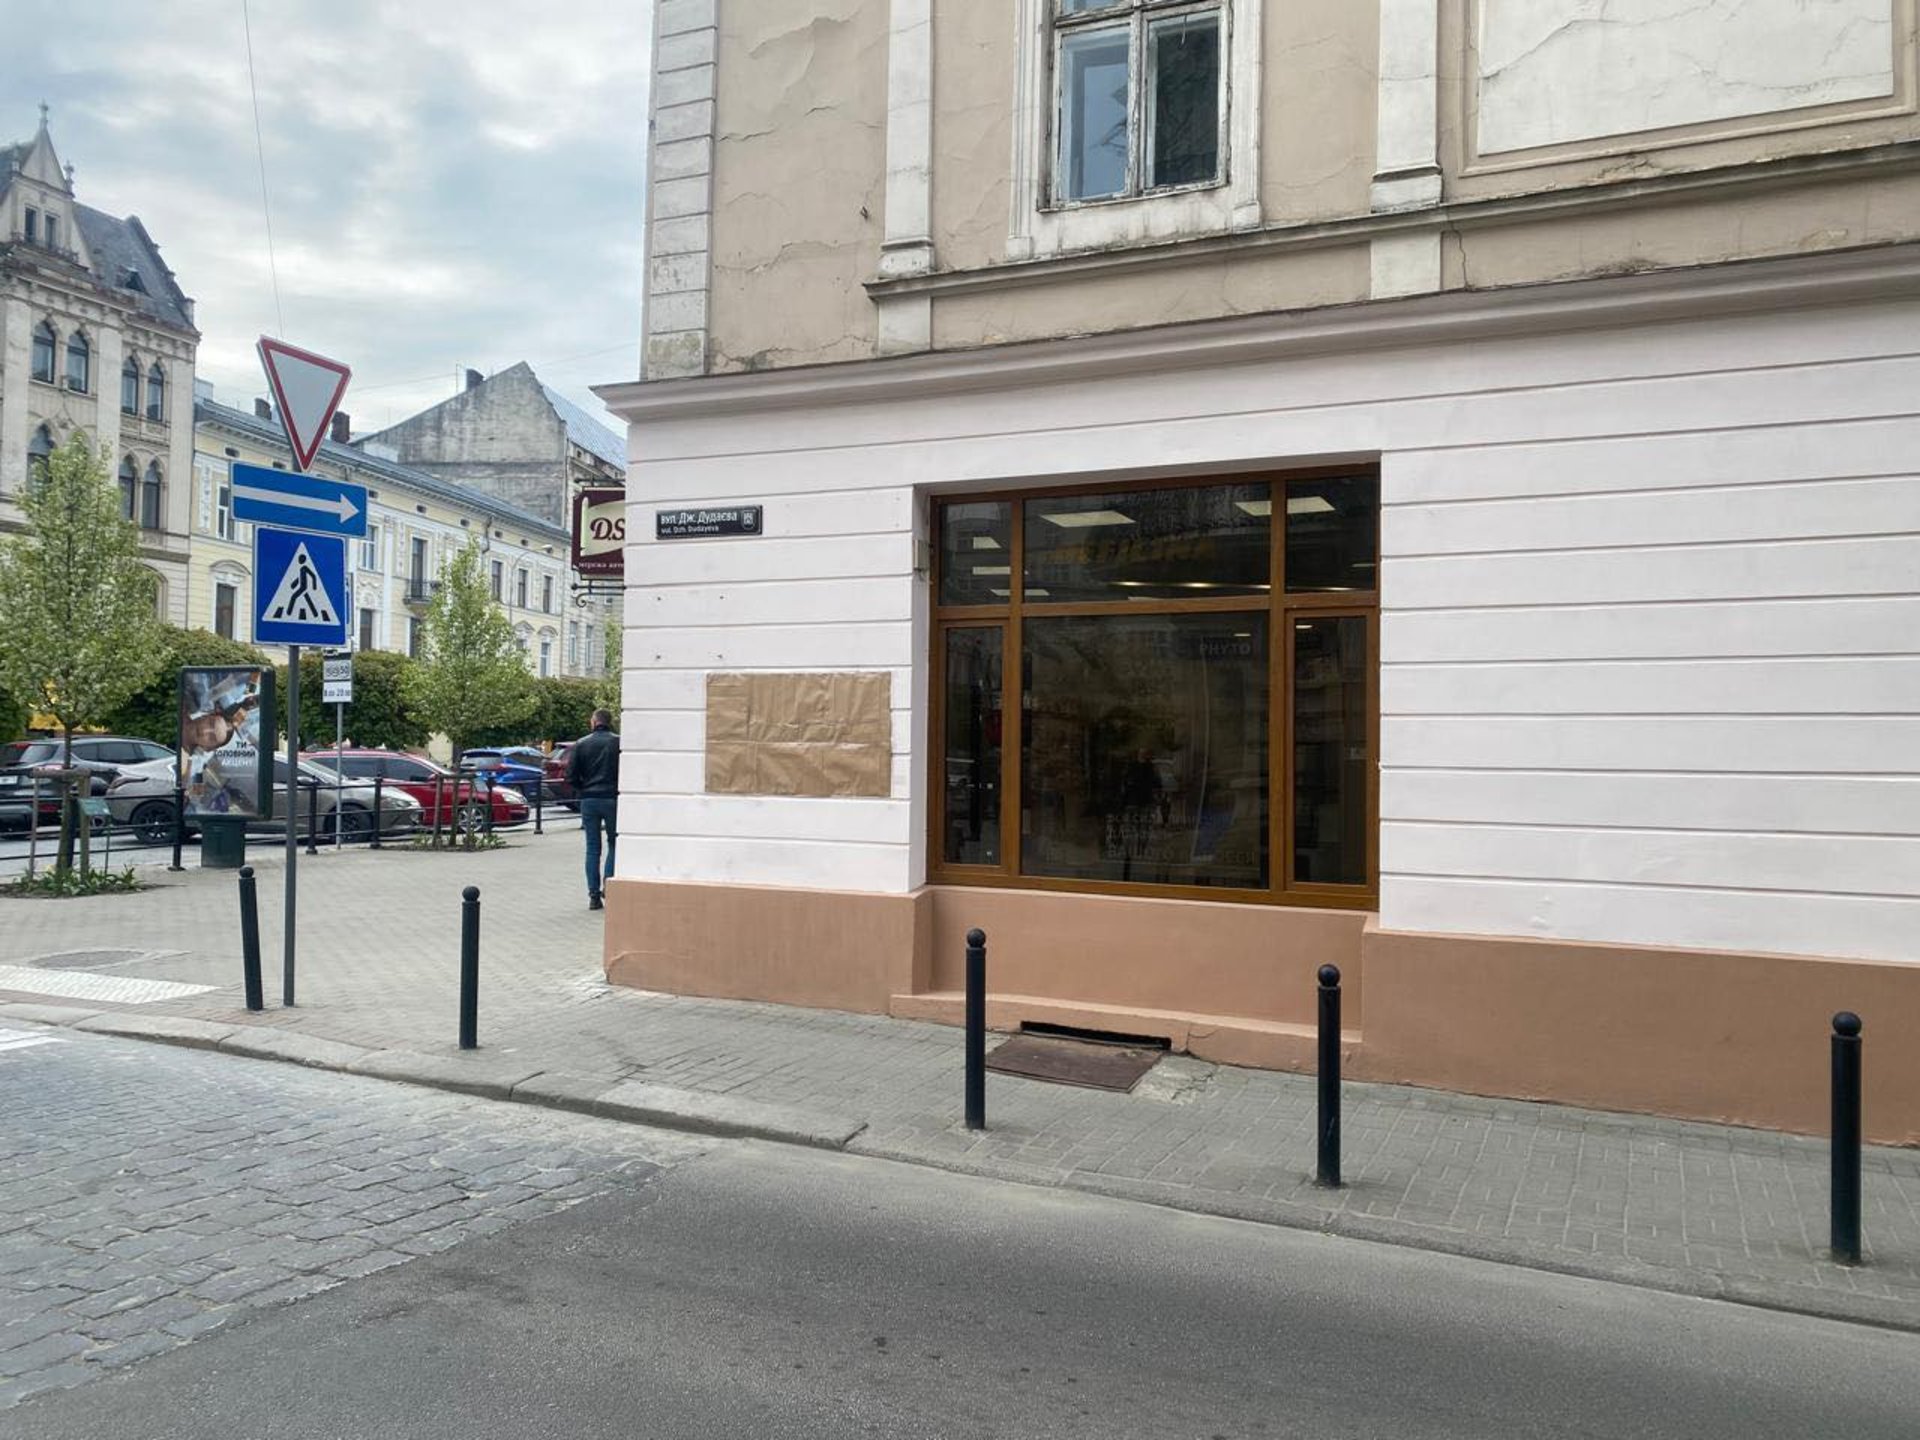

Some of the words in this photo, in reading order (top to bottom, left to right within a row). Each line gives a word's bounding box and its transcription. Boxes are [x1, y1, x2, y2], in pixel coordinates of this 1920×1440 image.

[661, 515, 676, 524] вул.
[678, 512, 696, 525] Дж.
[697, 511, 738, 524] Дудаєва
